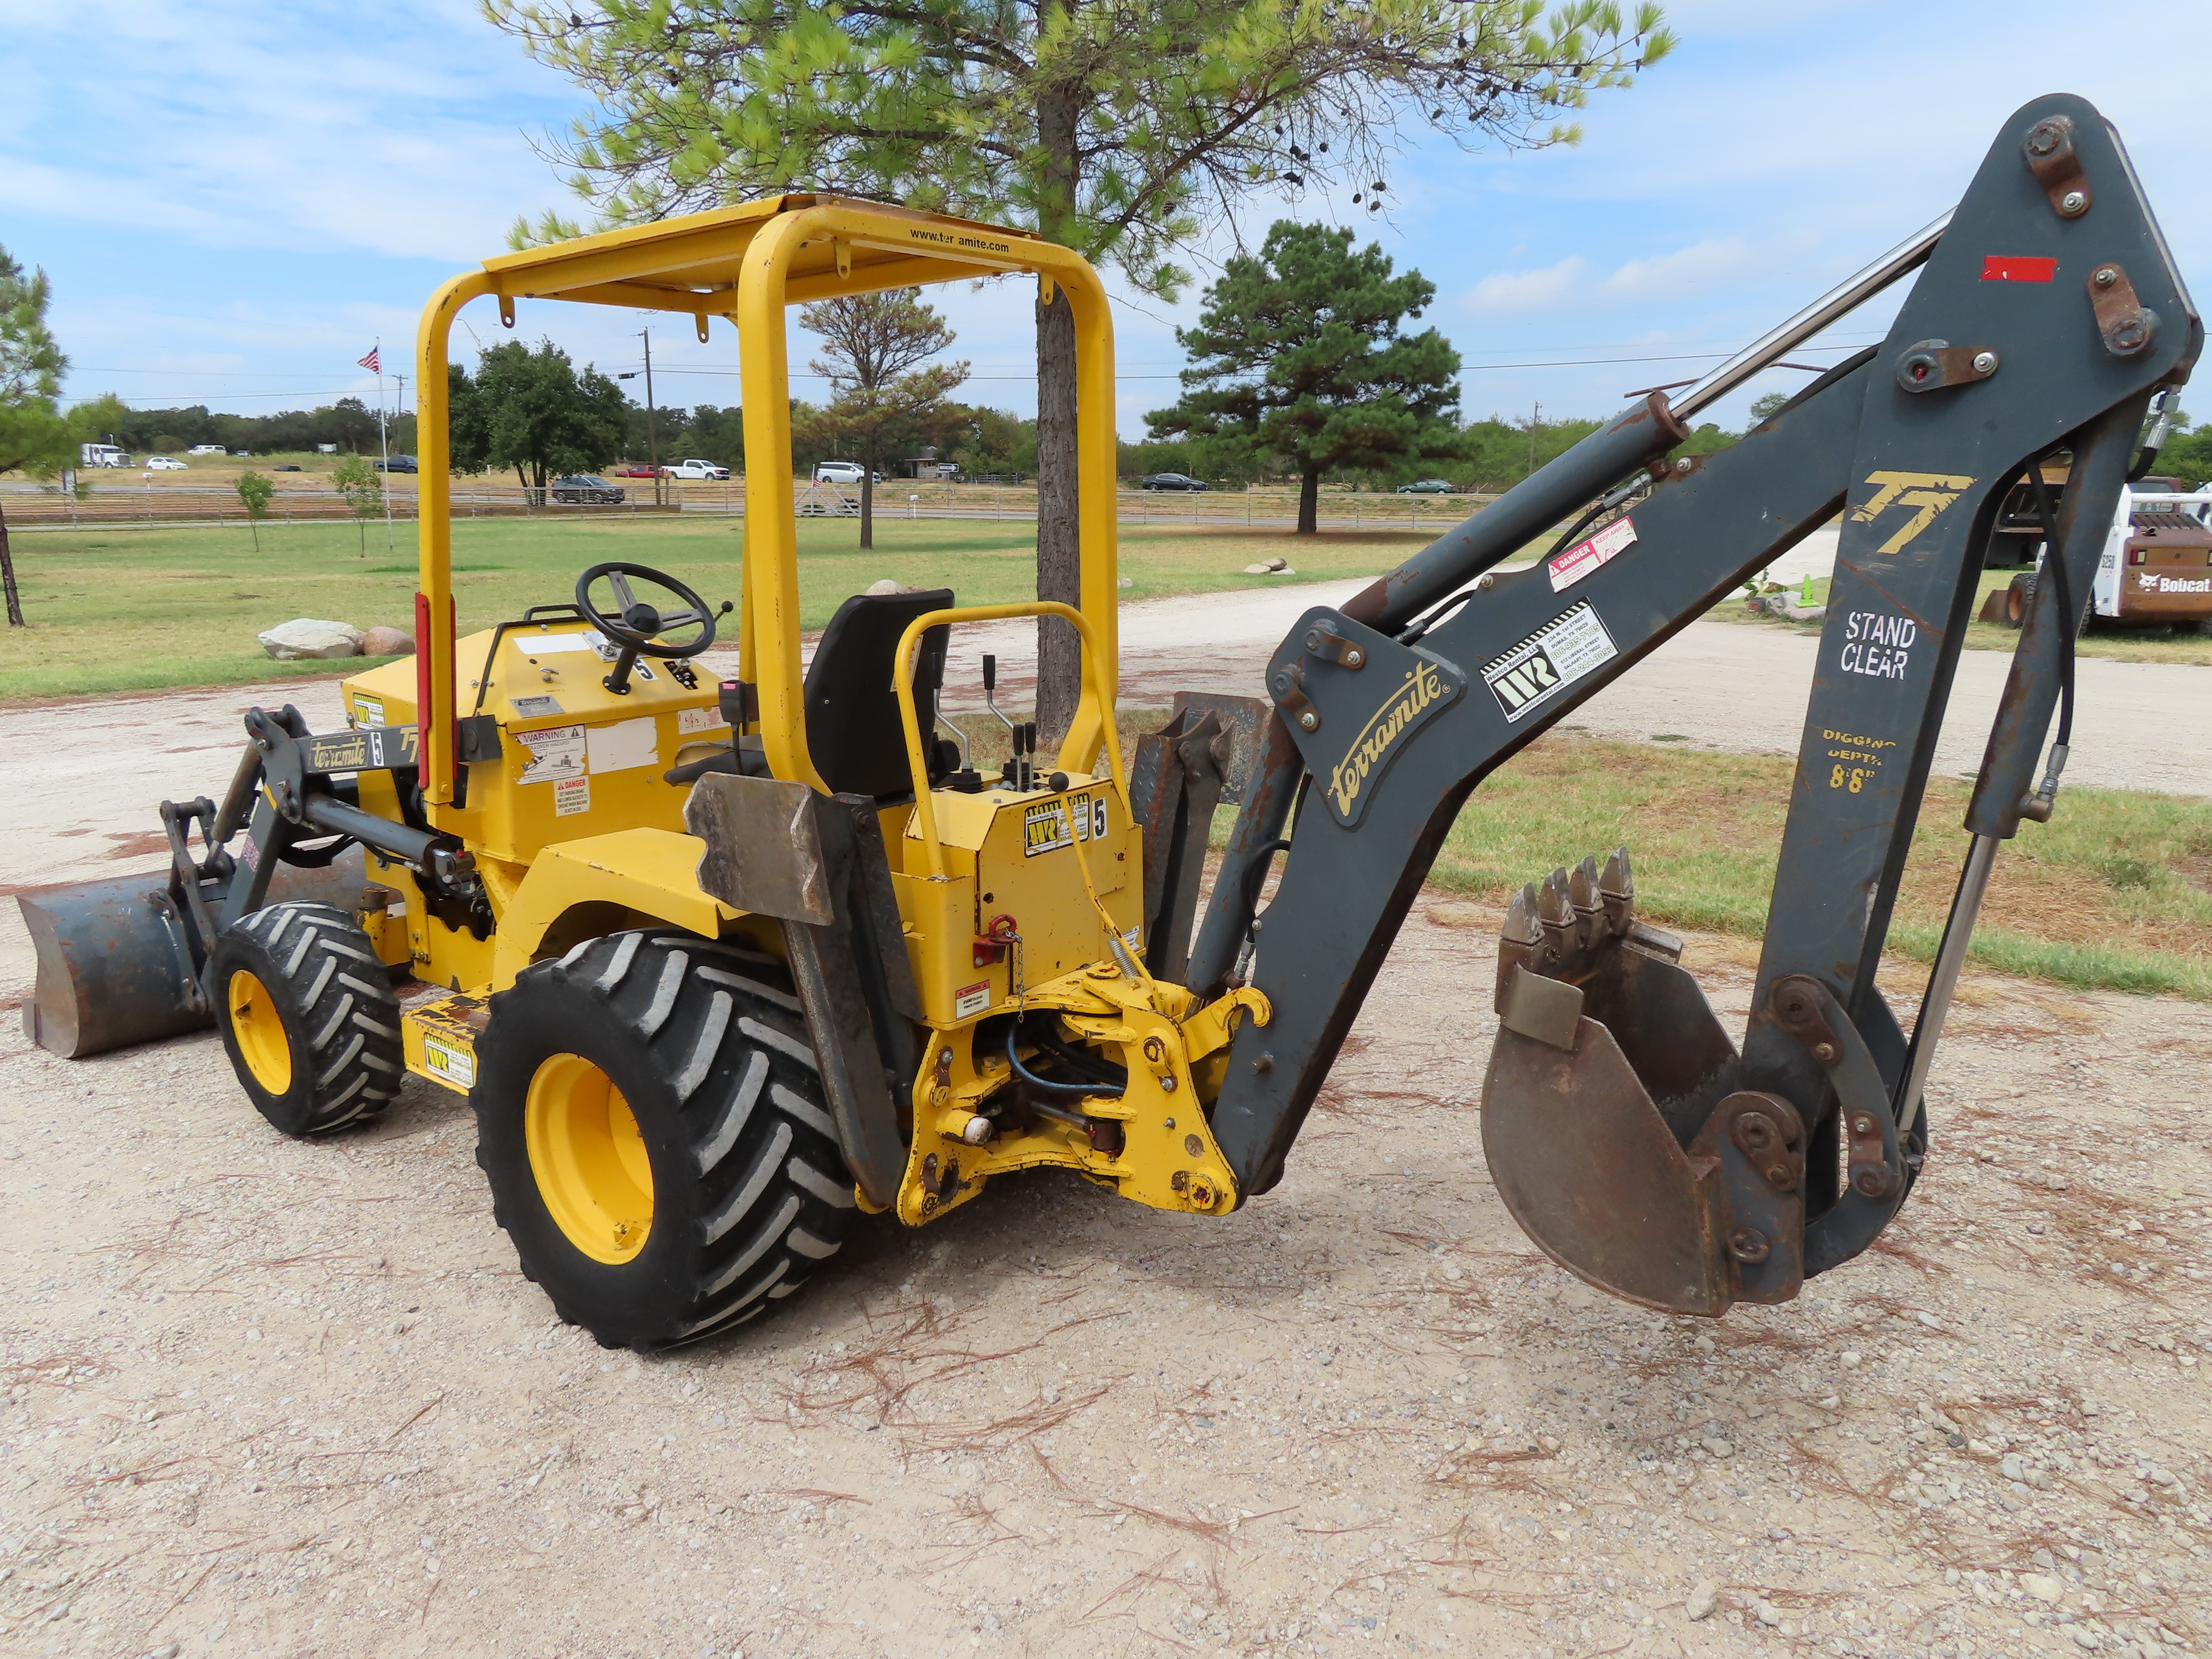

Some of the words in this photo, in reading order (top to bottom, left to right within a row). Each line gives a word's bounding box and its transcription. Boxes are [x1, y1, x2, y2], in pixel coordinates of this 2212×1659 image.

[1595, 533, 1609, 545] KEEP
[1558, 545, 1591, 569] DANGER
[2159, 577, 2210, 592] Bobcat
[1569, 614, 1586, 629] STREET
[1845, 610, 1917, 649] STAND
[1550, 623, 1601, 661] 806-935-7185
[1551, 637, 1569, 649] DUMAS,
[1575, 622, 1589, 633] 79029
[1568, 647, 1585, 660] LIBERAL
[1584, 637, 1600, 649] STREET
[634, 659, 653, 679] 5
[1486, 667, 1508, 682] Westco
[1508, 655, 1529, 668] Rental,
[1562, 645, 1615, 682] 806-244-3093
[1563, 658, 1583, 670] DALHART,
[1589, 645, 1601, 655] 79022
[1840, 643, 1908, 680] CLEAR
[1509, 682, 1565, 722] www.westcorental.com
[524, 729, 566, 743] WARNING
[1327, 660, 1441, 817] terramite
[312, 737, 366, 768] terramite
[373, 732, 383, 765] 5
[565, 779, 586, 789] DANGER
[1094, 799, 1104, 836] 5
